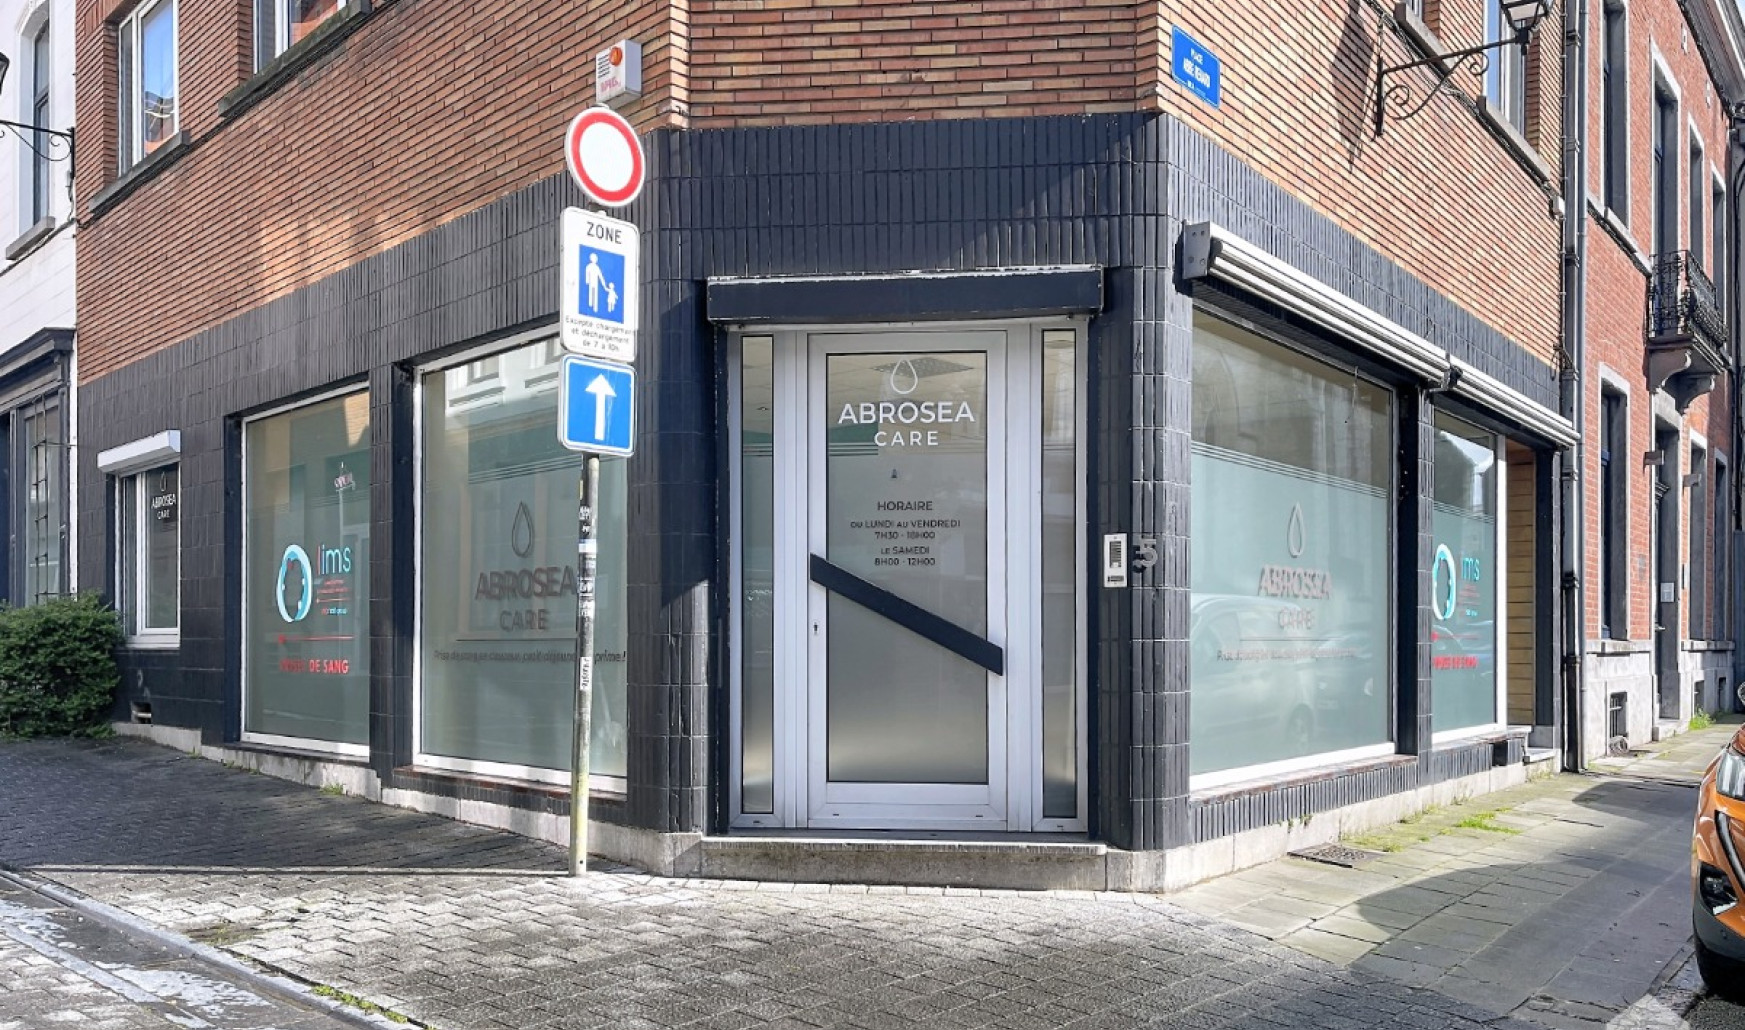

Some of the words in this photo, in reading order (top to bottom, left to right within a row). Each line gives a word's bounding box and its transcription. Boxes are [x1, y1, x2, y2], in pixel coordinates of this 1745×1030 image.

[586, 221, 622, 245] ZONE
[838, 401, 975, 424] ABROSEA
[874, 431, 939, 447] CARE
[877, 500, 933, 511] HORAIRE
[156, 509, 170, 520] CARE
[865, 520, 894, 528] LUNDI
[911, 519, 961, 528] VENDREDI
[874, 531, 899, 539] 7H30
[892, 546, 930, 554] SAMEDI
[874, 558, 899, 566] 8H00
[907, 558, 936, 566] 12H00
[474, 565, 577, 600] ABROSEA
[1258, 564, 1332, 600] ABROSEA
[501, 609, 550, 632] CARE
[309, 659, 321, 673] DE
[323, 658, 350, 674] SANG
